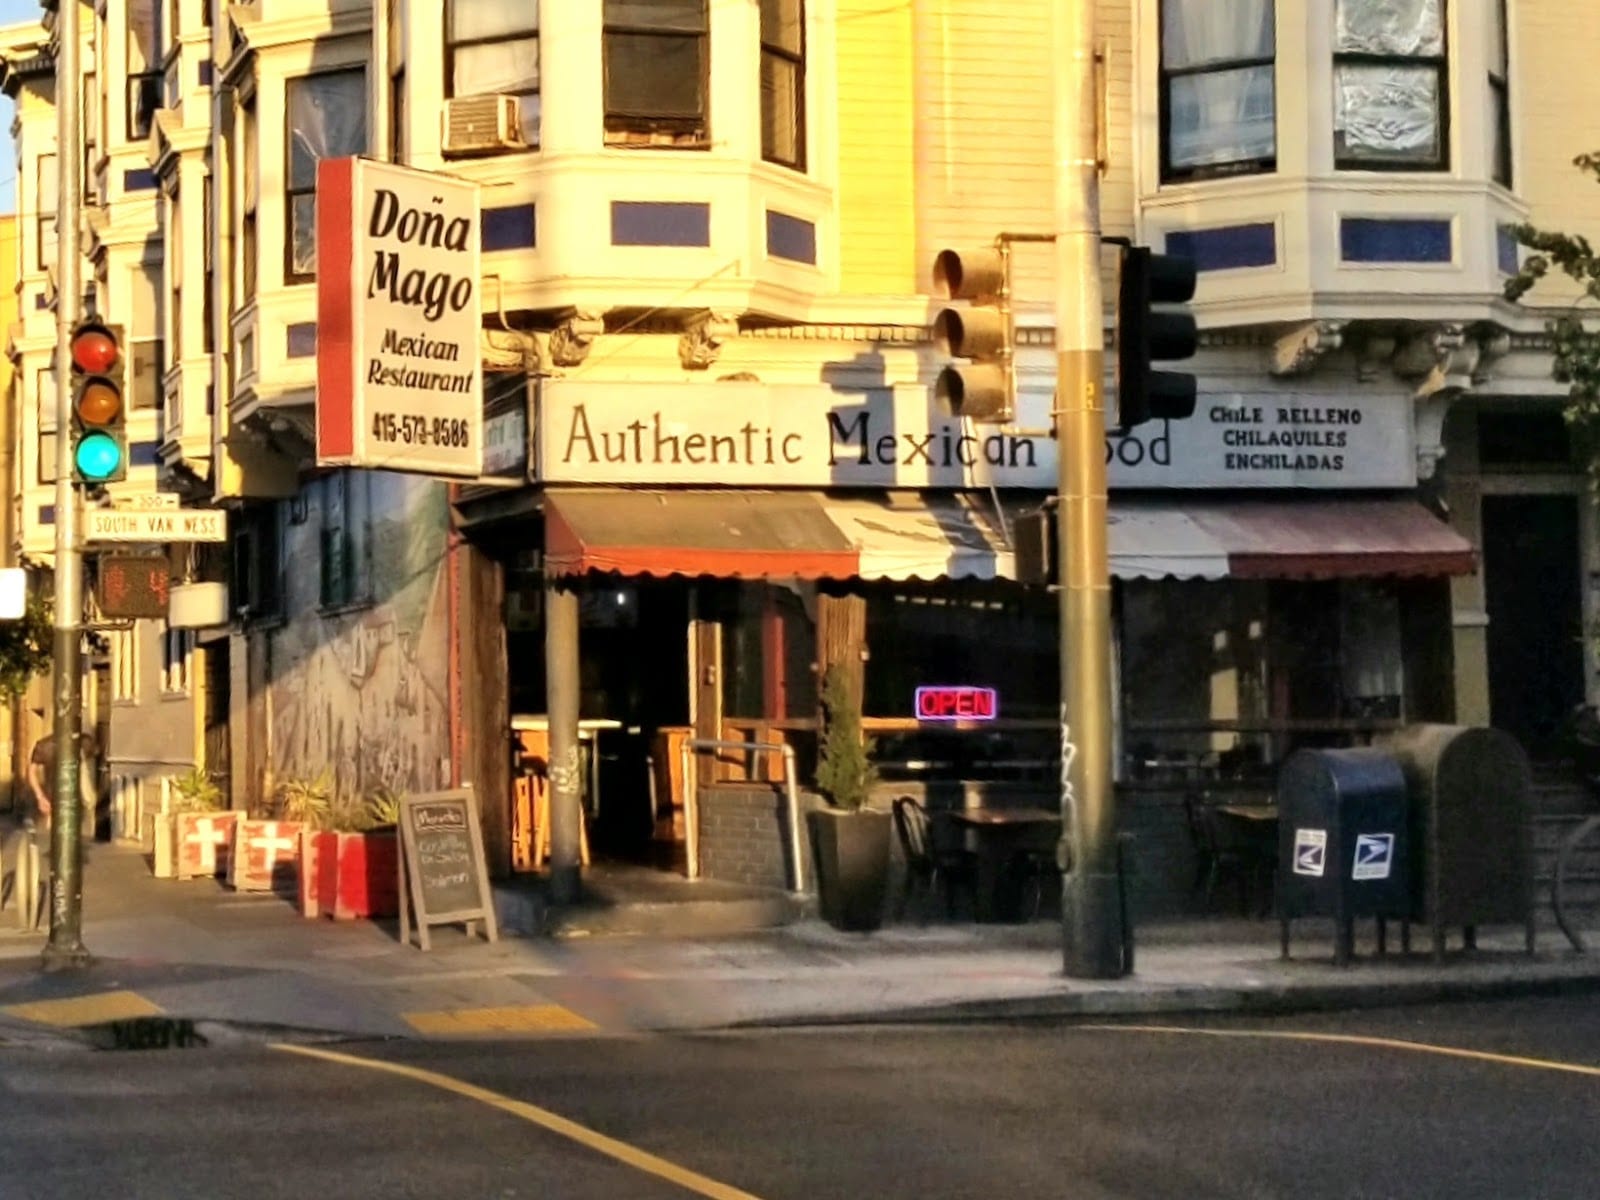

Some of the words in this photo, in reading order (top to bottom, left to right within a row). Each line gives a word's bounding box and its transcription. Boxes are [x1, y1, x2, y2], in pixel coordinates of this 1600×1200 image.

[368, 188, 471, 252] Doña
[367, 249, 472, 322] Mago
[380, 328, 459, 362] Mexican
[367, 358, 473, 394] Restaurant
[372, 411, 470, 448] 415-573-8586
[1209, 406, 1264, 423] CHILE
[1277, 408, 1362, 425] RELLENO
[562, 403, 803, 465] Authentic
[826, 412, 1036, 467] Mexican
[1105, 418, 1170, 466] od
[1223, 429, 1347, 448] CHILAQUILES
[1225, 453, 1344, 471] ENCHILADAS
[95, 516, 138, 533] SOUTH
[148, 516, 173, 532] VAN
[184, 517, 216, 533] NESS
[920, 690, 992, 715] OPEN
